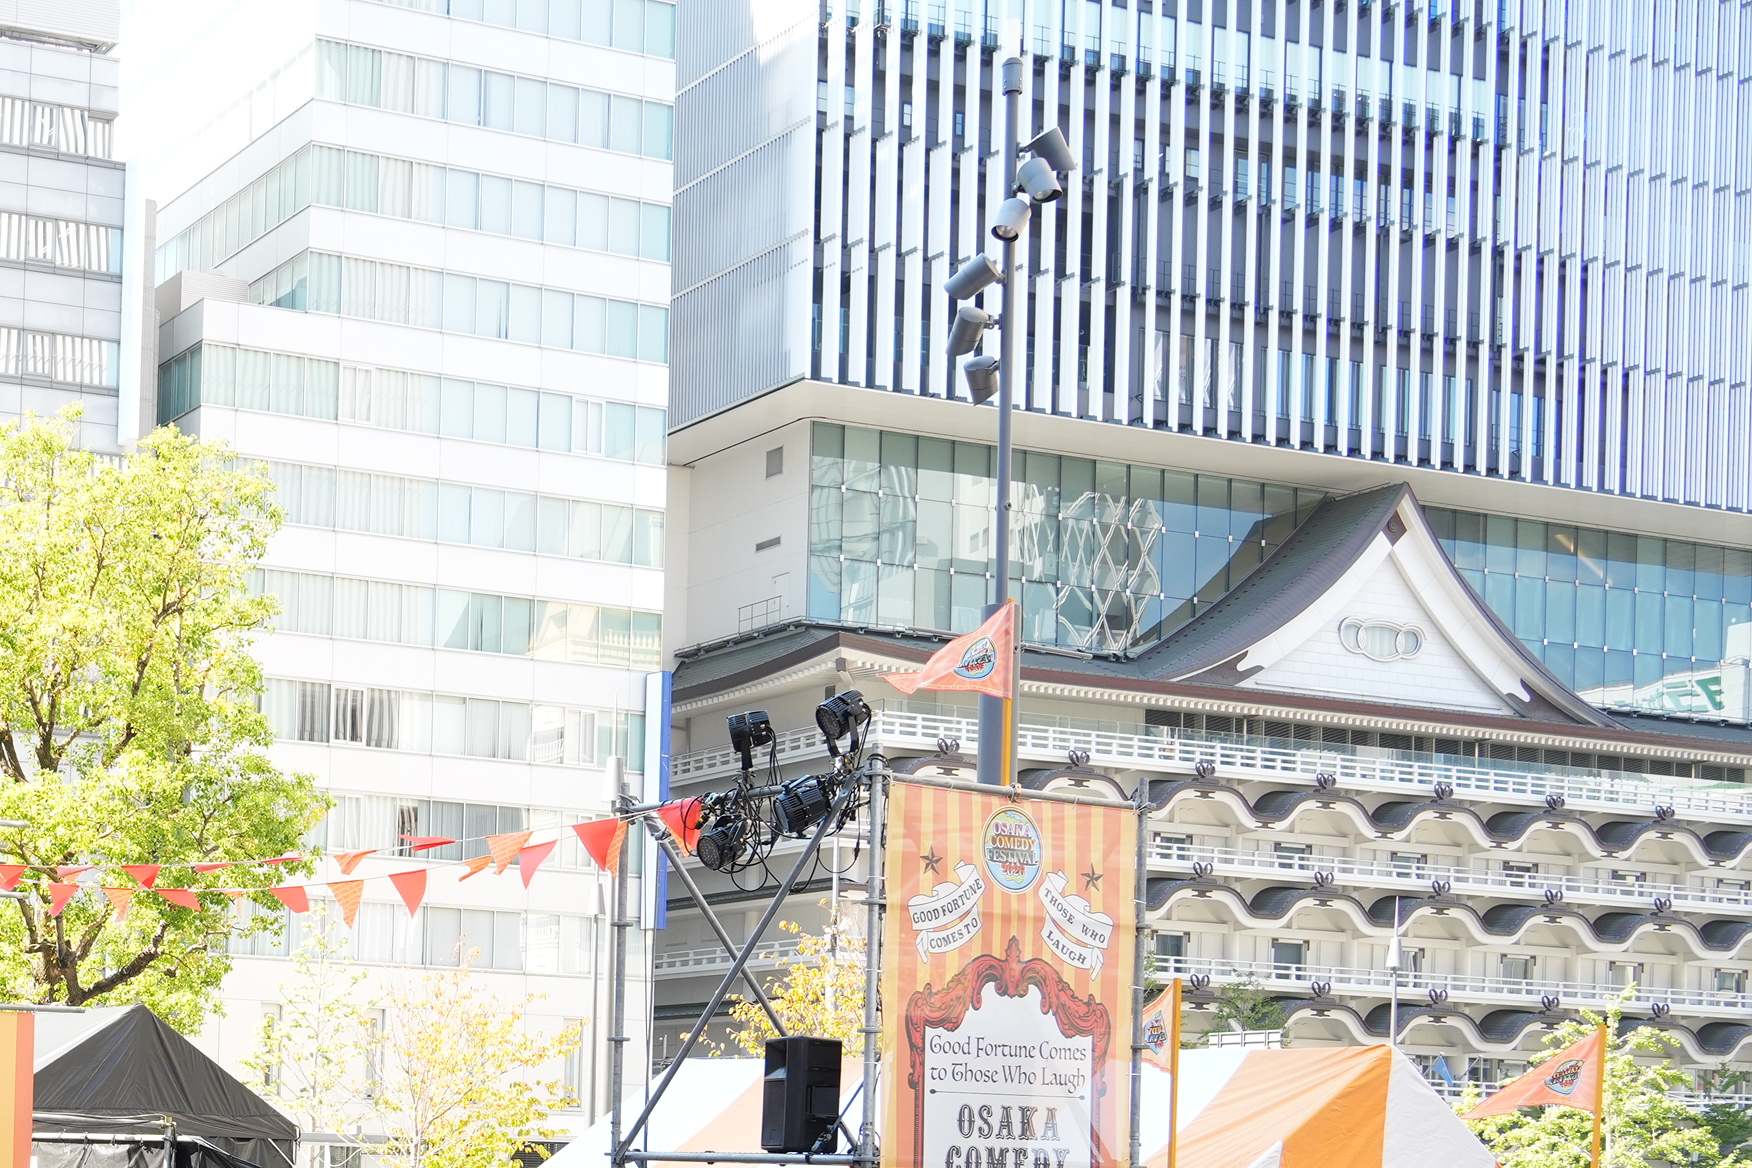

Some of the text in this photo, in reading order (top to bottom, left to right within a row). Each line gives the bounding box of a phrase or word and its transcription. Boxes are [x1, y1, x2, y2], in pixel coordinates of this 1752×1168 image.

[989, 835, 1036, 851] COMEDY
[993, 821, 1032, 838] OSAKA
[986, 848, 1040, 865] FESTIVAL
[1000, 863, 1026, 878] 2026
[912, 877, 983, 925] GOOD FORTUNE
[1044, 887, 1106, 944] THOSE WHO
[929, 917, 979, 950] COMES TO
[1046, 930, 1087, 966] LAUGH
[929, 1034, 1087, 1062] Good Fortune Comes
[930, 1062, 1086, 1094] to Those Who Laugh
[957, 1103, 1061, 1142] OSAKA
